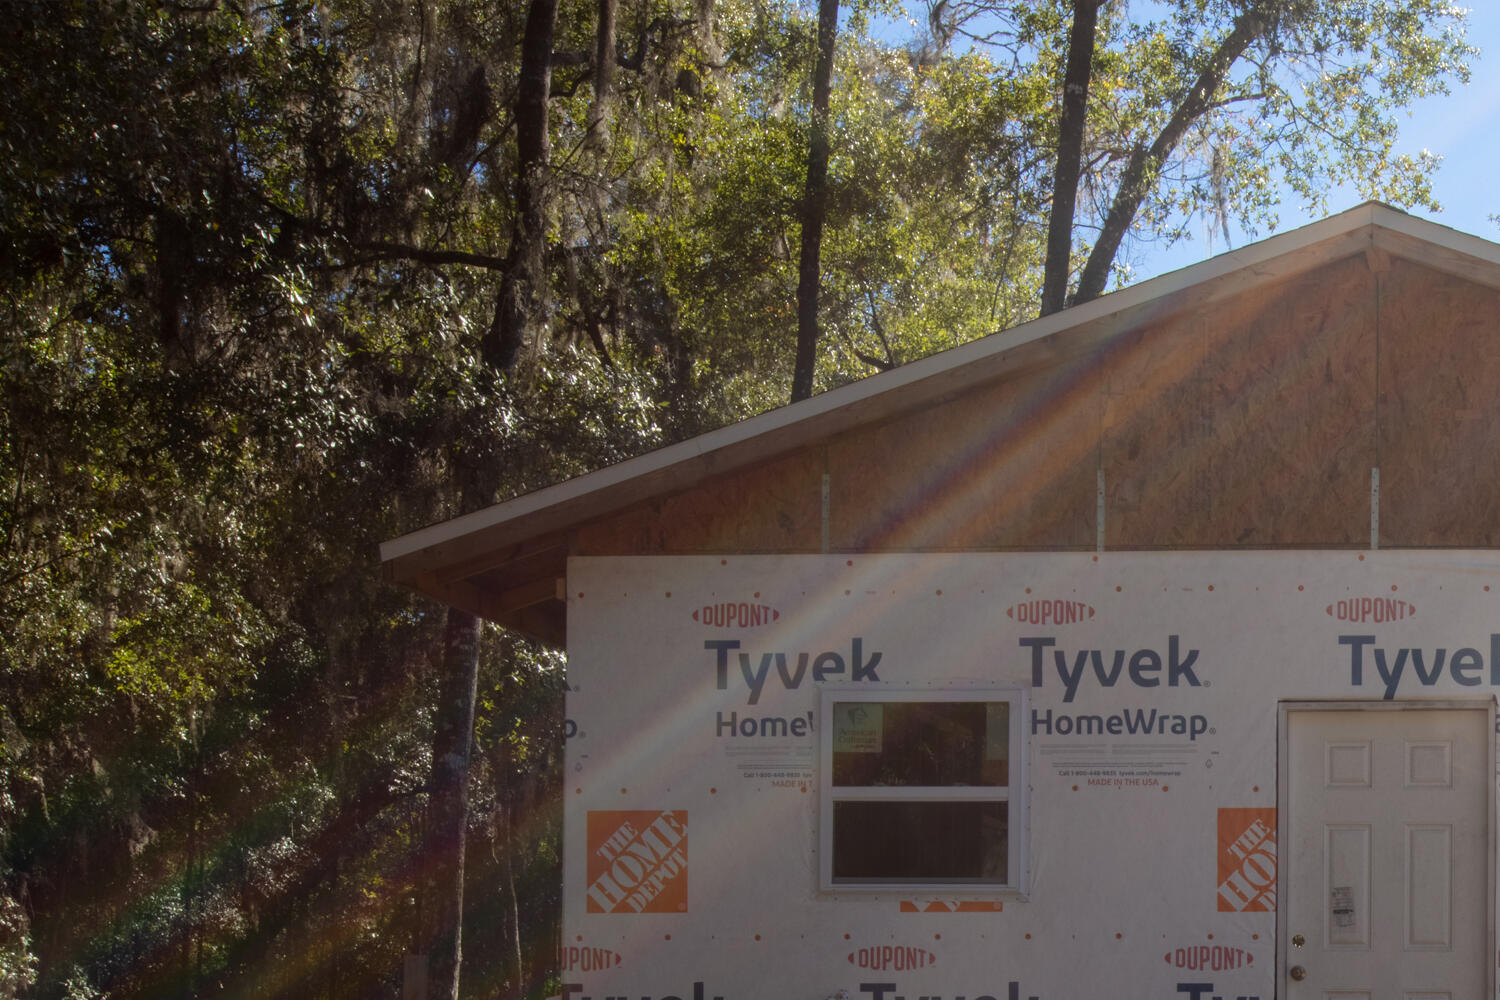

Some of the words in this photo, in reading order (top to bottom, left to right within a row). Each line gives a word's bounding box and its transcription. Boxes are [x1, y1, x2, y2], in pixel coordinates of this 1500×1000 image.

[703, 603, 770, 628] DUPONT
[1017, 600, 1086, 625] DUPONT
[1337, 597, 1406, 623] DUPONT
[704, 638, 883, 706] Tyvek
[1019, 635, 1202, 702] Tyvek
[1032, 709, 1208, 740] HomeWrap
[1087, 778, 1112, 786] MADE
[1114, 778, 1123, 786] IN
[1124, 778, 1140, 786] THE
[1142, 778, 1159, 786] USA
[596, 820, 639, 863] THE
[1226, 818, 1271, 861] THE
[587, 810, 688, 913] HOME
[626, 848, 689, 913] DEPOT
[561, 947, 612, 972] UPONT
[858, 946, 926, 971] DUPONT
[1175, 946, 1244, 971] DUPONT
